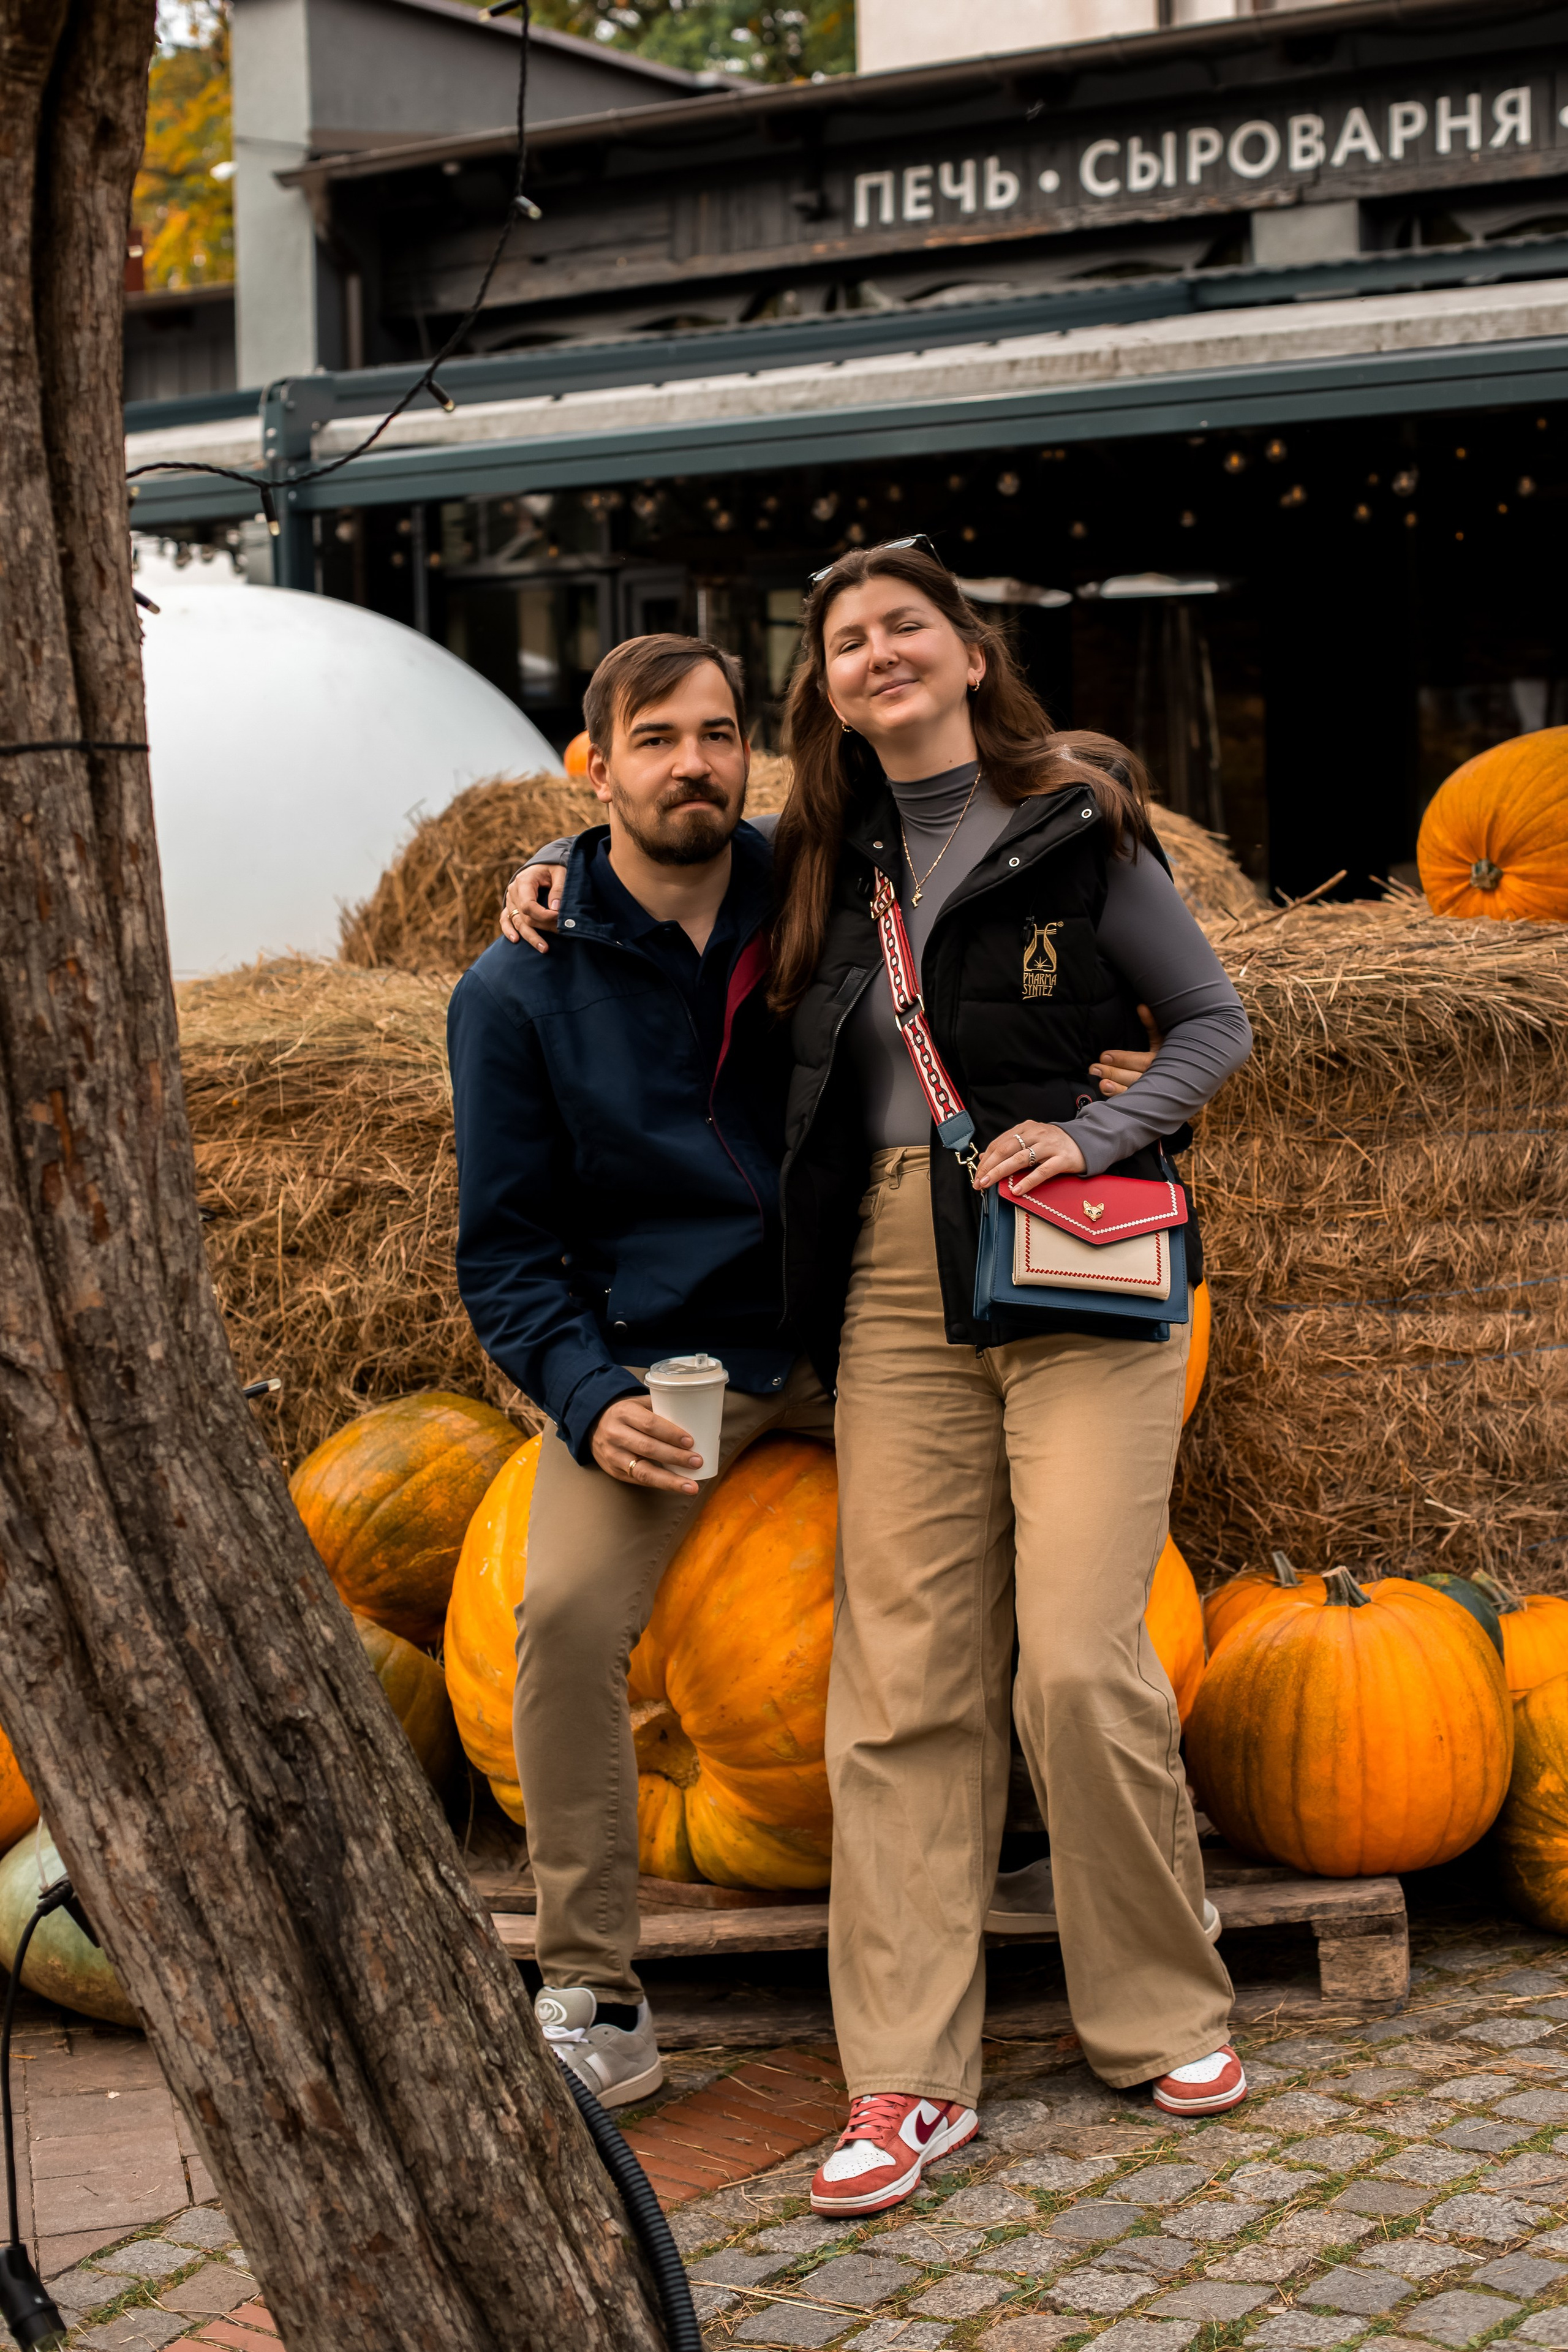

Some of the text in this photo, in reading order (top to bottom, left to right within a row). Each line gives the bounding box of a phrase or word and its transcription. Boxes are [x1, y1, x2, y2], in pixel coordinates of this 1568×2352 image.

[854, 86, 1531, 228] ПЕЧЬ СЫРОВАРНЯ
[1023, 973, 1057, 986] PHARMA
[1022, 984, 1053, 1000] SYNTEZ
